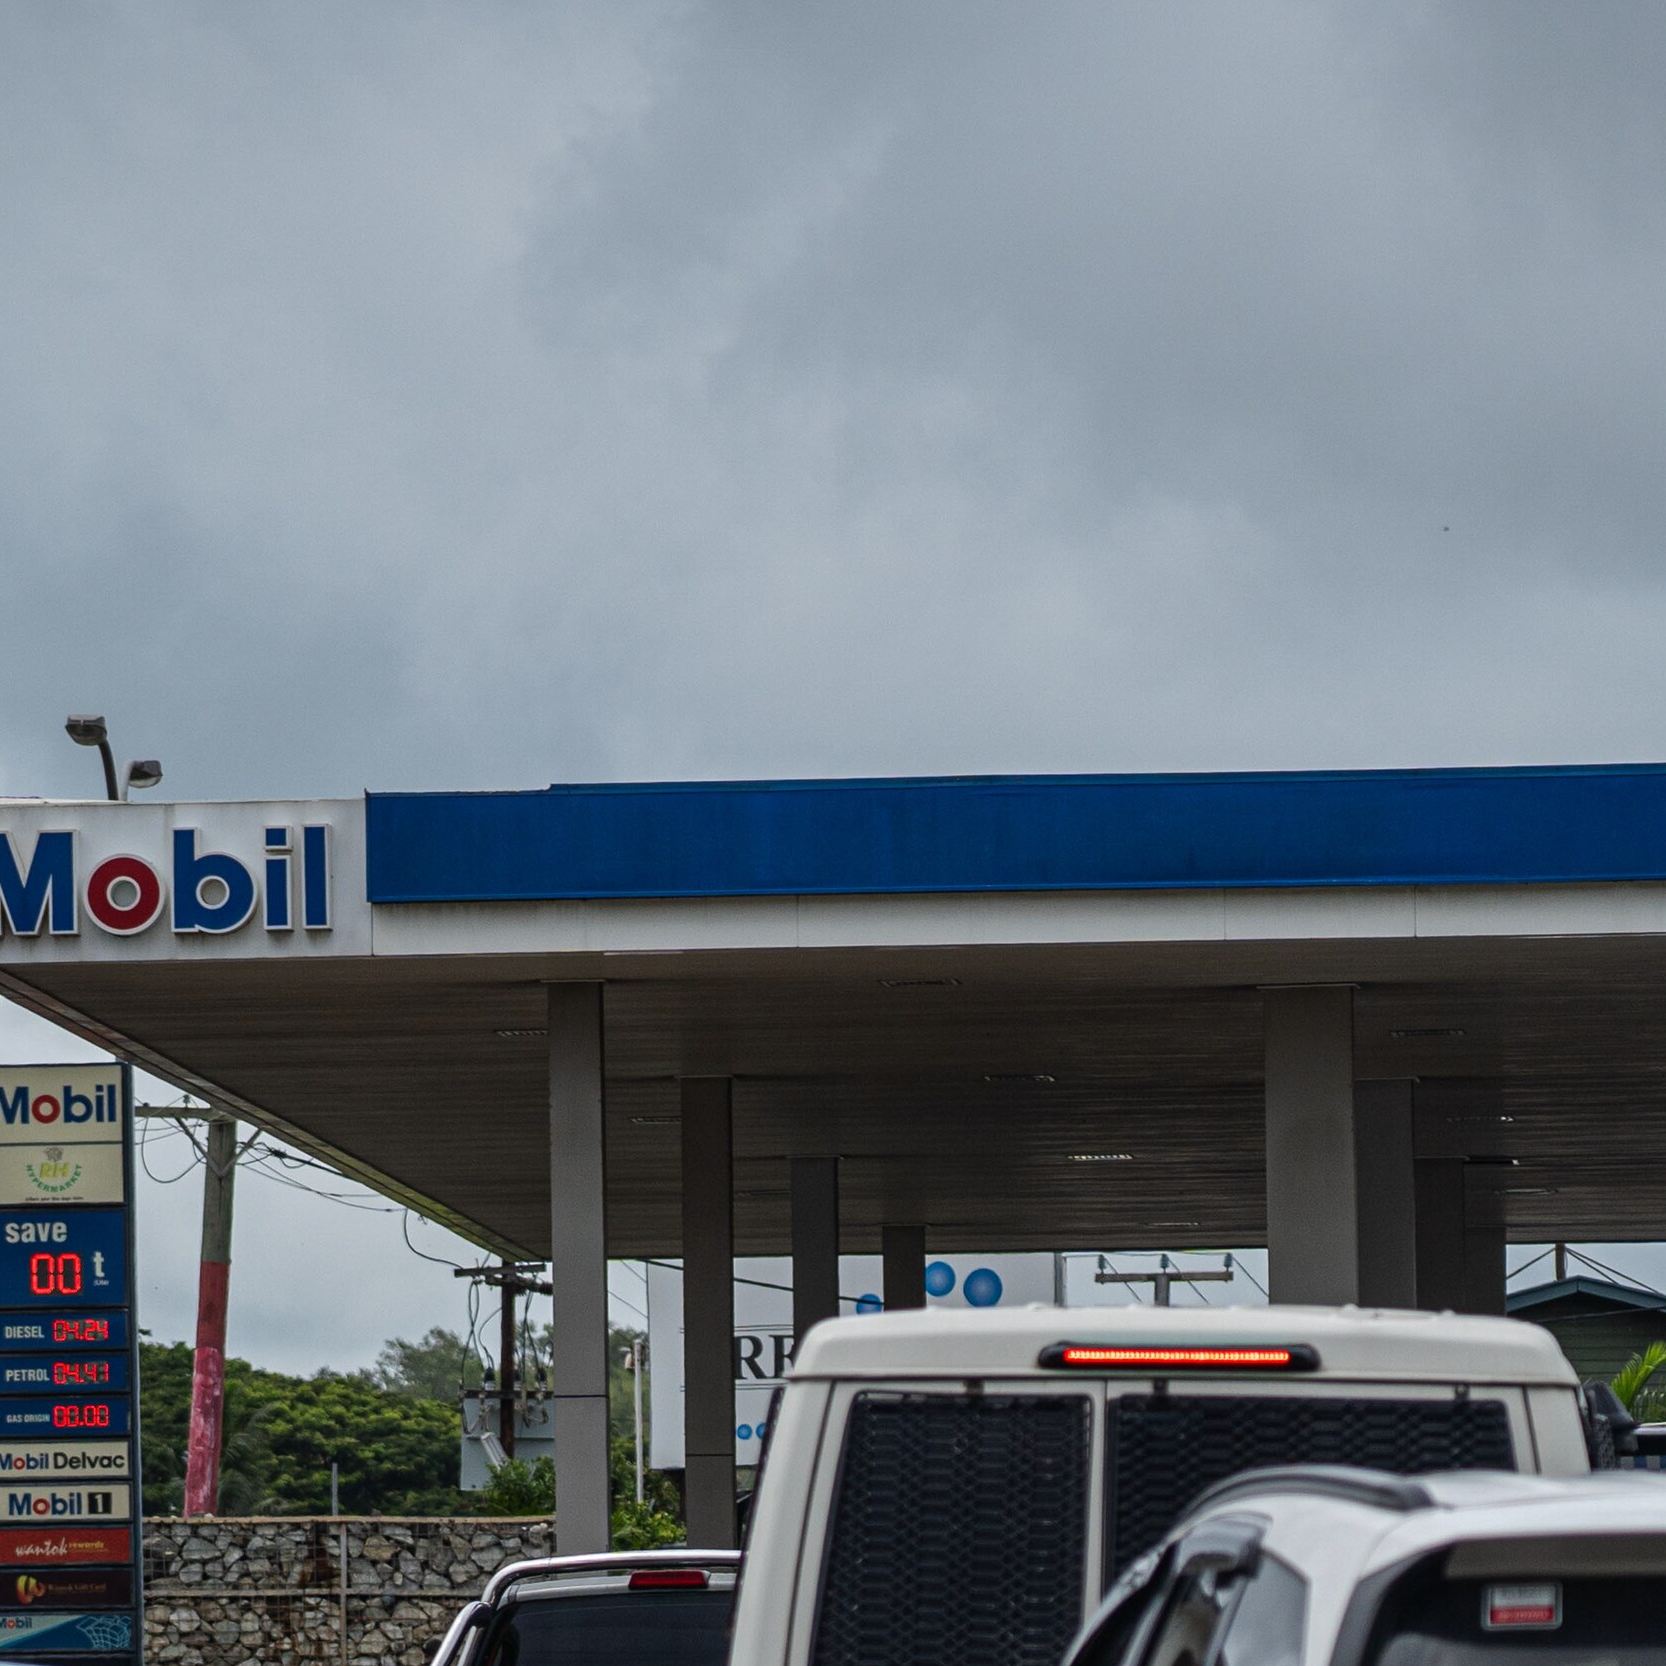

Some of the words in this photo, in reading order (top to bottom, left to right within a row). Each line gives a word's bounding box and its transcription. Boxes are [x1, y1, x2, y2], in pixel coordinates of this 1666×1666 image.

[26, 1164, 83, 1193] HYPERMARKET
[39, 1162, 70, 1178] RH
[5, 1222, 68, 1243] save
[30, 1253, 82, 1295] 00
[93, 1251, 105, 1277] t
[5, 1326, 45, 1339] DIESEL
[52, 1318, 109, 1342] 04.24
[5, 1369, 50, 1382] PETROL
[53, 1404, 109, 1428] 00.00
[53, 1451, 125, 1469] Delvac
[8, 1492, 82, 1516] Mobil
[15, 1537, 68, 1558] wantok
